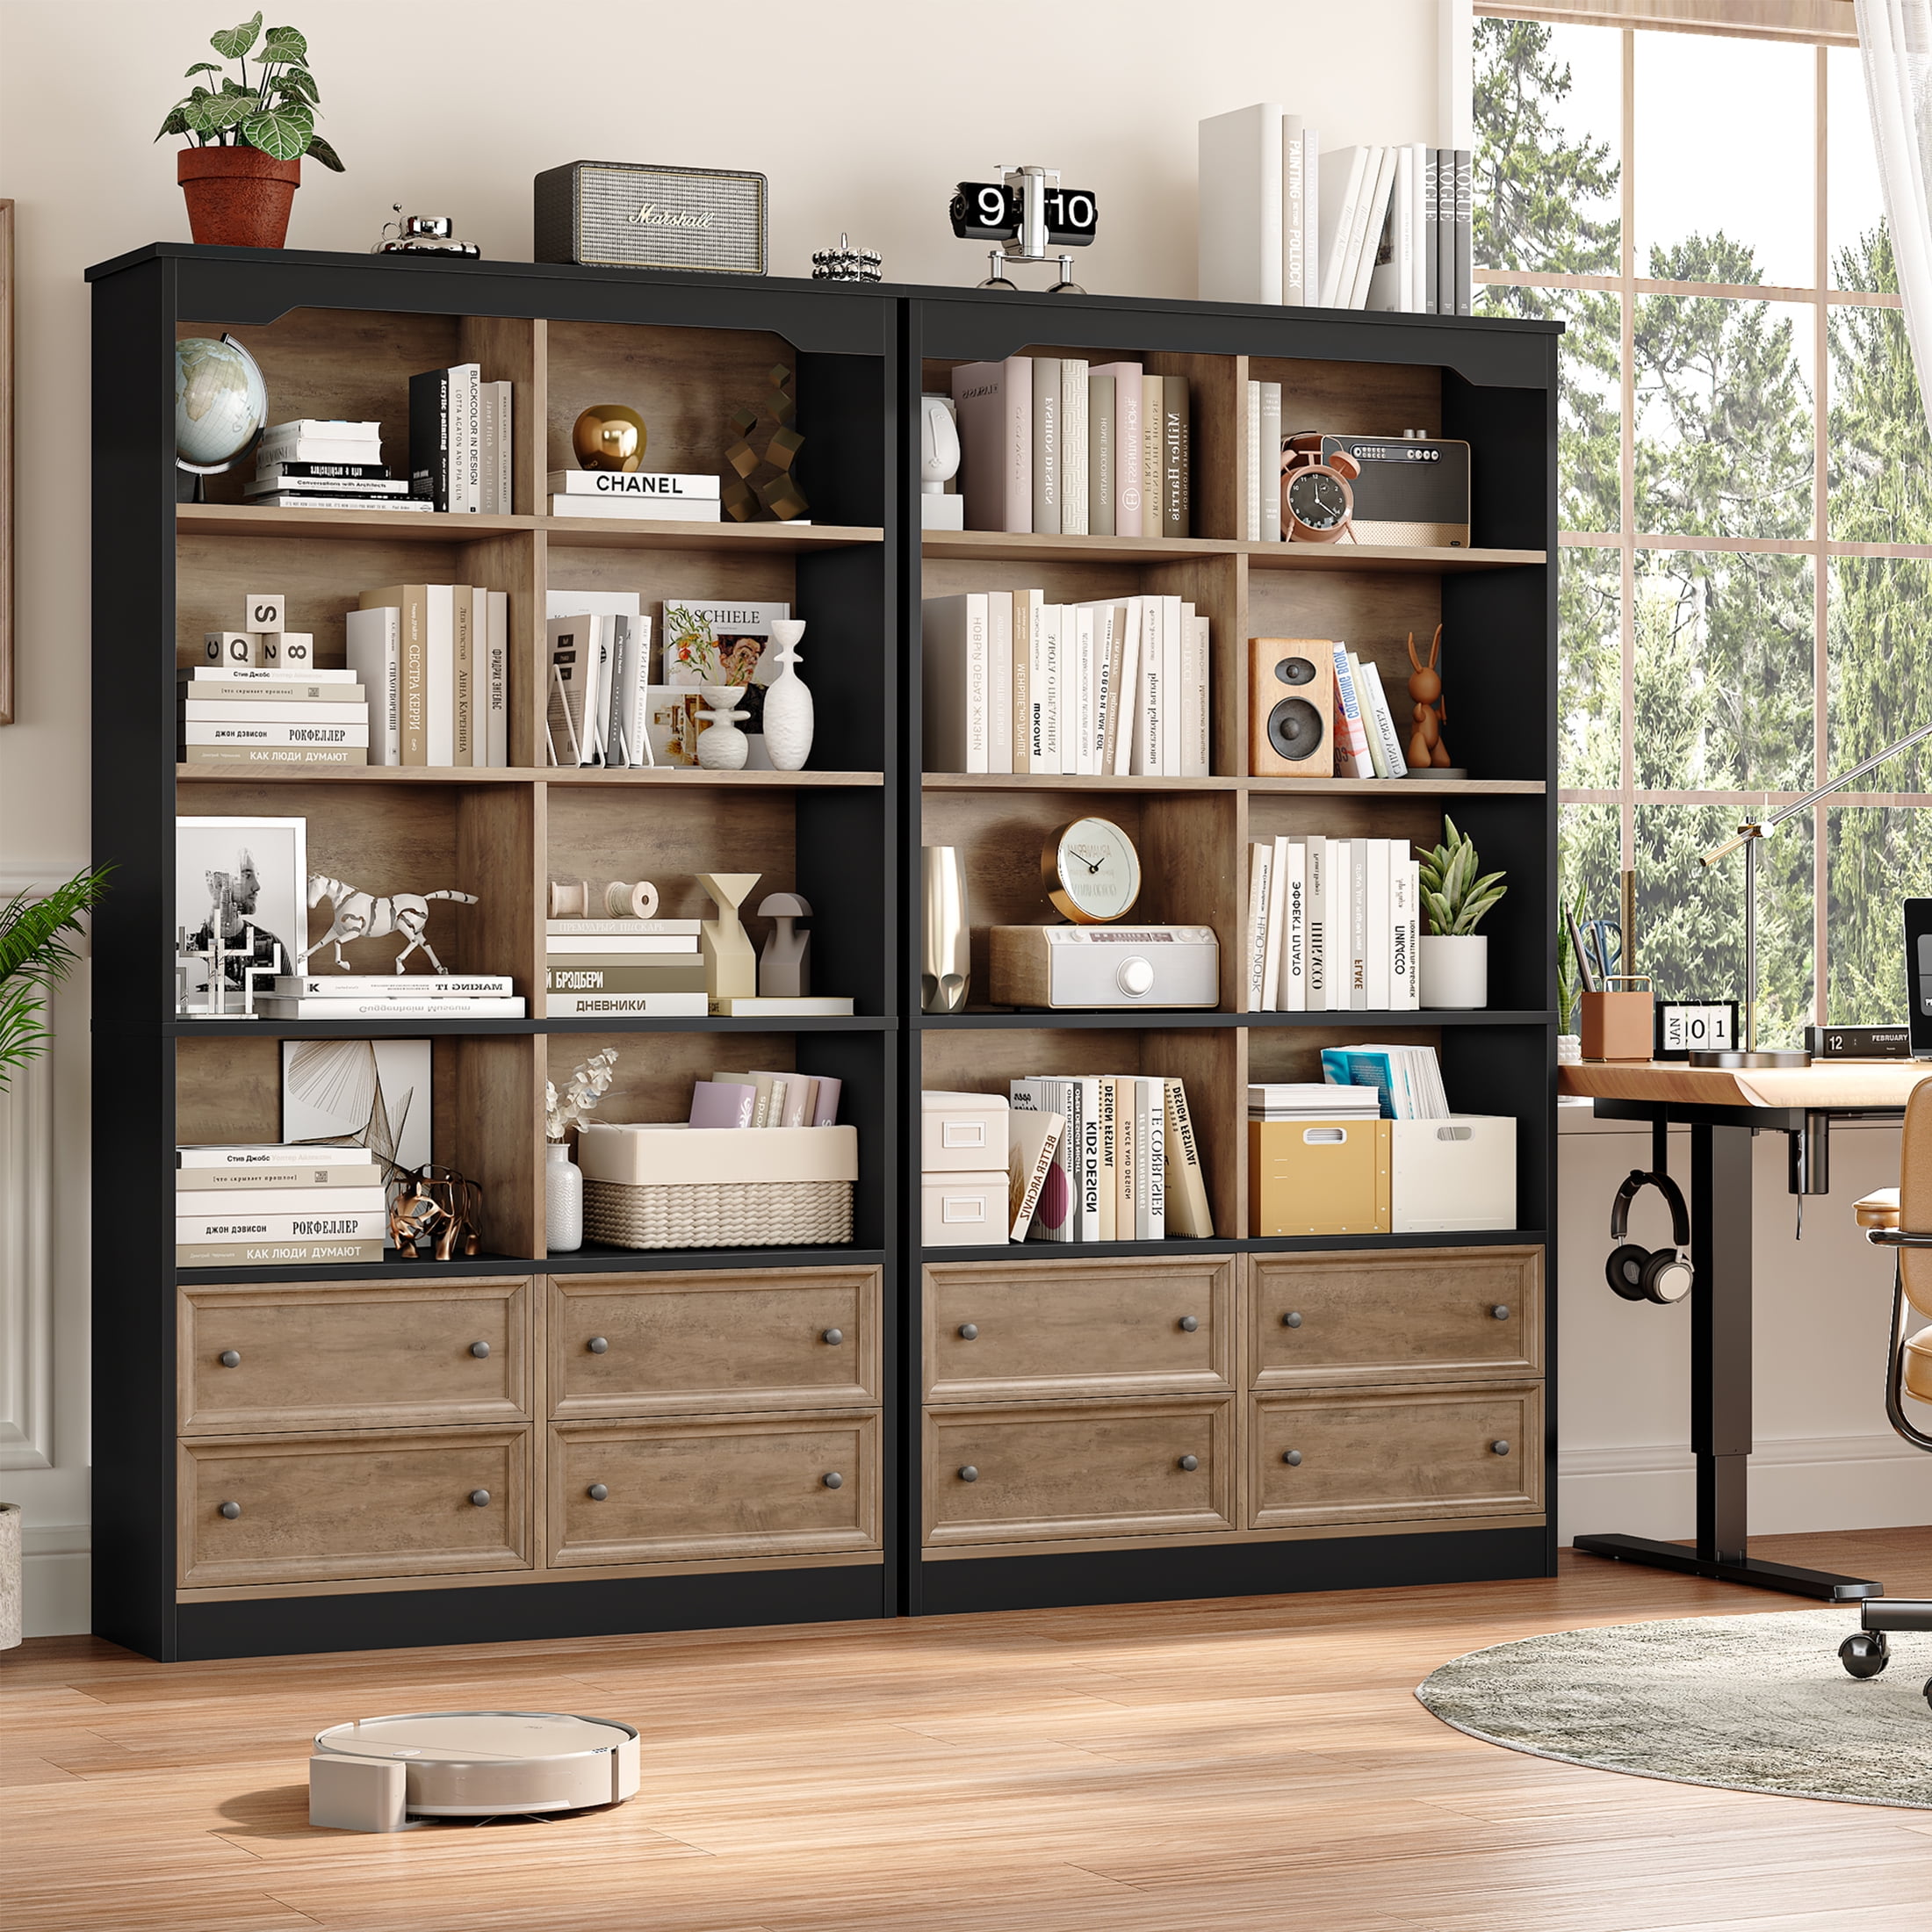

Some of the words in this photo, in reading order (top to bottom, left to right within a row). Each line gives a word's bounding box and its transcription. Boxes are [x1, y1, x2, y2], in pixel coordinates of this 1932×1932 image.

[1289, 141, 1301, 198] PAINTING
[1426, 162, 1438, 221] VOGUE
[1440, 162, 1454, 221] VOGUE
[1456, 163, 1471, 222] VOGUE
[629, 203, 715, 228] Marshall
[977, 187, 1005, 226] 9
[1048, 194, 1093, 227] 10
[1289, 229, 1301, 288] POLLOCK
[470, 437, 478, 447] IN
[596, 474, 683, 494] CHANEL
[255, 605, 277, 623] S
[694, 609, 761, 624] SCHIELE
[230, 638, 249, 662] Q
[288, 645, 306, 660] 8
[409, 645, 421, 689] СЕСТРА
[492, 648, 502, 681] ФРИДРИХ
[492, 682, 502, 710] ЭНГЕЛЬС
[409, 693, 421, 731] КЕРРИ
[289, 729, 346, 743] РОКФЕЛЛЕР
[250, 752, 270, 761] КАК
[271, 752, 301, 761] ЛЮДИ
[306, 752, 348, 761] ДУМАЮТ
[556, 971, 603, 989] БРЭДБЕРИ
[576, 999, 646, 1013] ДНЕВНИКИ
[1669, 1018, 1681, 1045] JAN
[1829, 1035, 1842, 1050] 12
[205, 1225, 229, 1235] ДЖОН
[231, 1225, 267, 1235] ДЭВИСОН
[292, 1221, 358, 1235] РОКФЕЛЛЕР
[247, 1249, 270, 1259] КАК
[272, 1248, 306, 1260] ЛЮДИ
[311, 1246, 362, 1259] ДУМАЮТ
